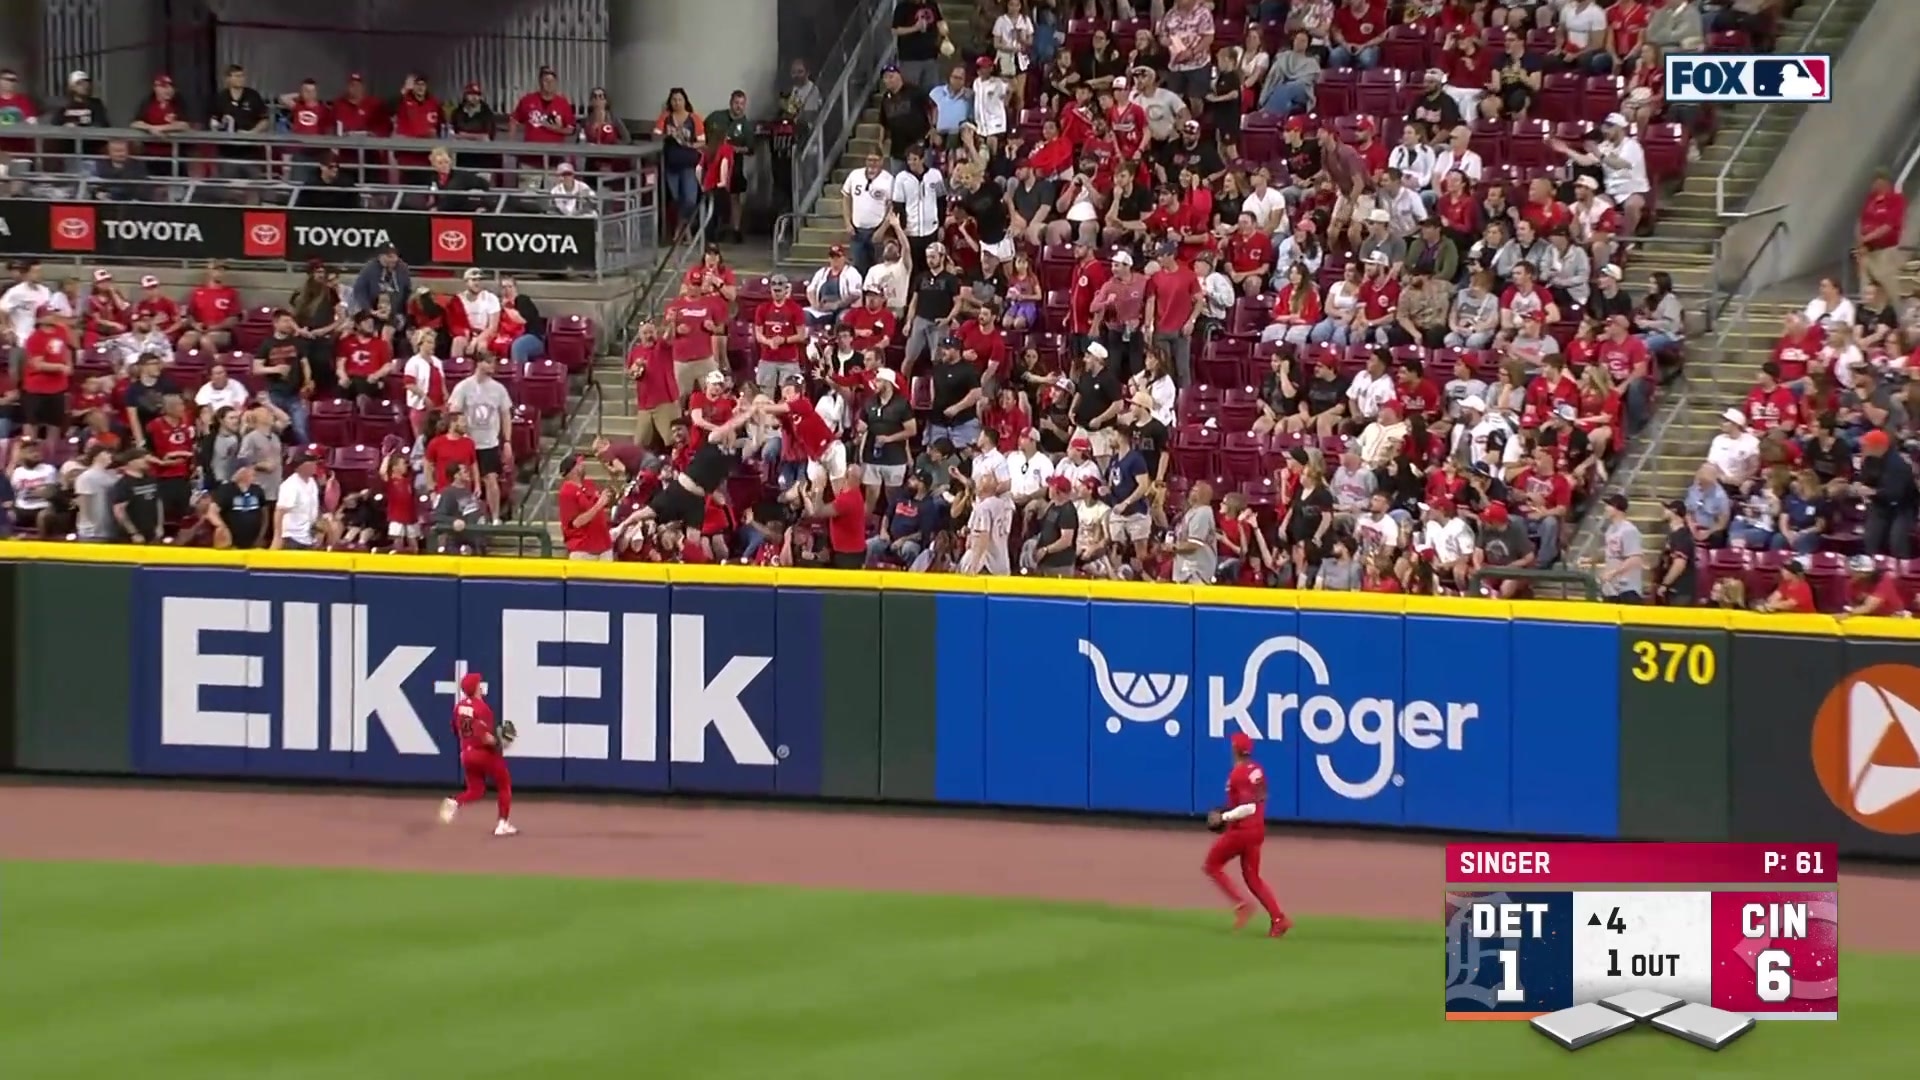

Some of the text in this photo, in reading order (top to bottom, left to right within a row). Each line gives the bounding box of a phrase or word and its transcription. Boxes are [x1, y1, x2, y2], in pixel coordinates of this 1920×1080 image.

[103, 220, 203, 242] TOYOTA
[294, 226, 390, 249] TOYOTA
[481, 232, 579, 255] TOYOTA
[1631, 640, 1716, 686] 370
[1208, 635, 1479, 799] Kroger
